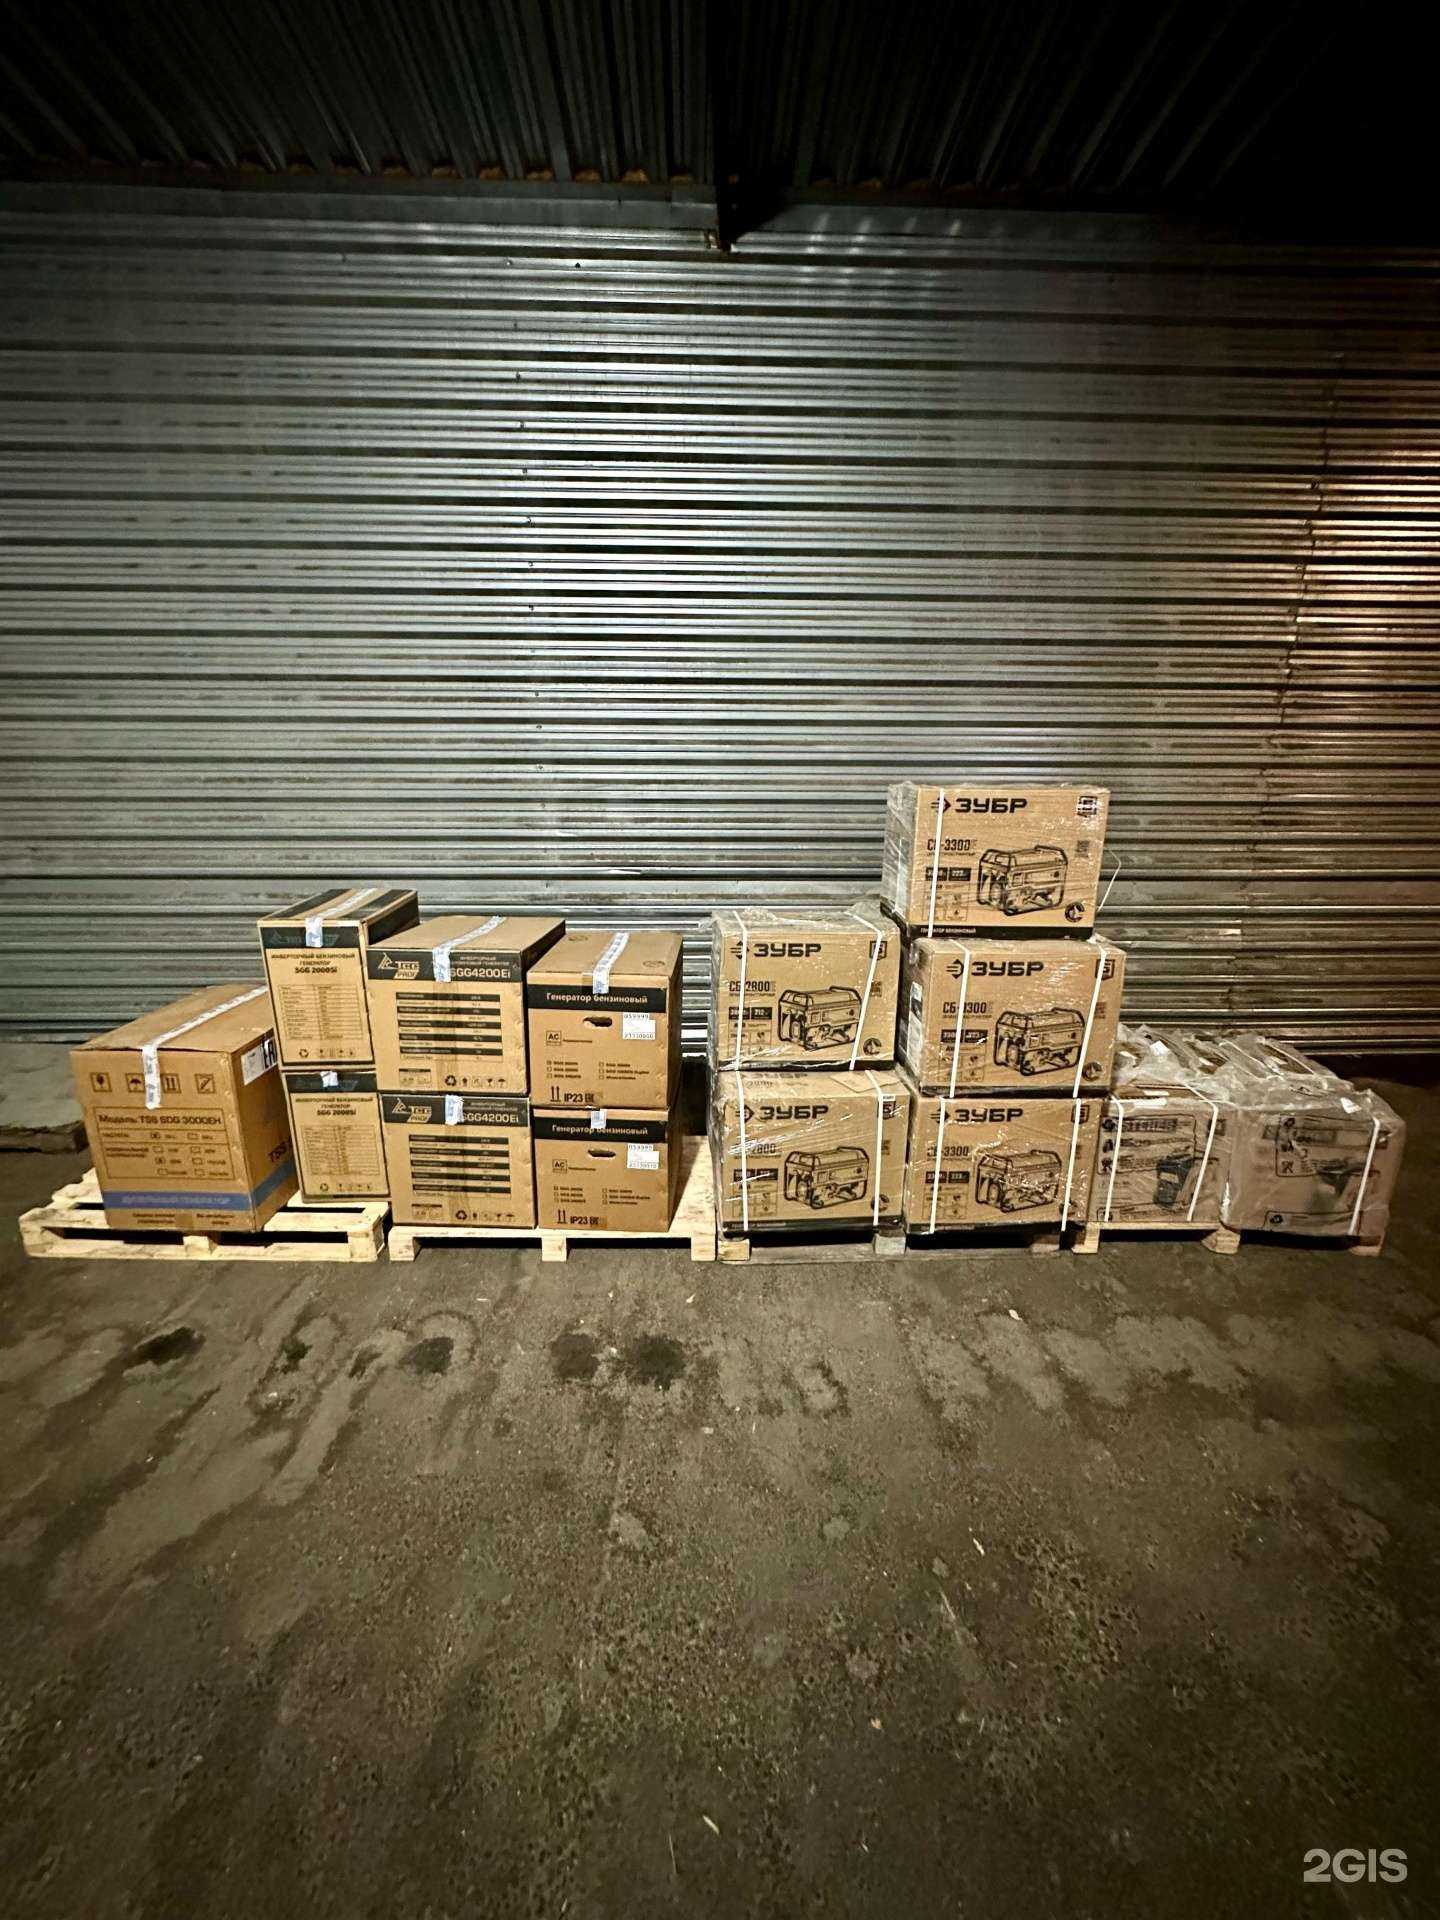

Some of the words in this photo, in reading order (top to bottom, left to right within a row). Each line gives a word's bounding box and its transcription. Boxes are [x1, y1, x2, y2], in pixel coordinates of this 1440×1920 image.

[955, 797, 1028, 813] ЗУБР
[754, 943, 821, 957] ЗУБР
[971, 961, 1044, 976] ЗУБР
[546, 992, 592, 1003] Генератор
[593, 994, 648, 1003] бензиновый
[564, 1093, 584, 1103] IP23
[759, 1104, 829, 1120] ЗУБР
[954, 1107, 1023, 1122] ЗУБР
[551, 1124, 595, 1134] Генератор
[596, 1126, 648, 1135] бензиновый
[570, 1215, 588, 1225] IP23
